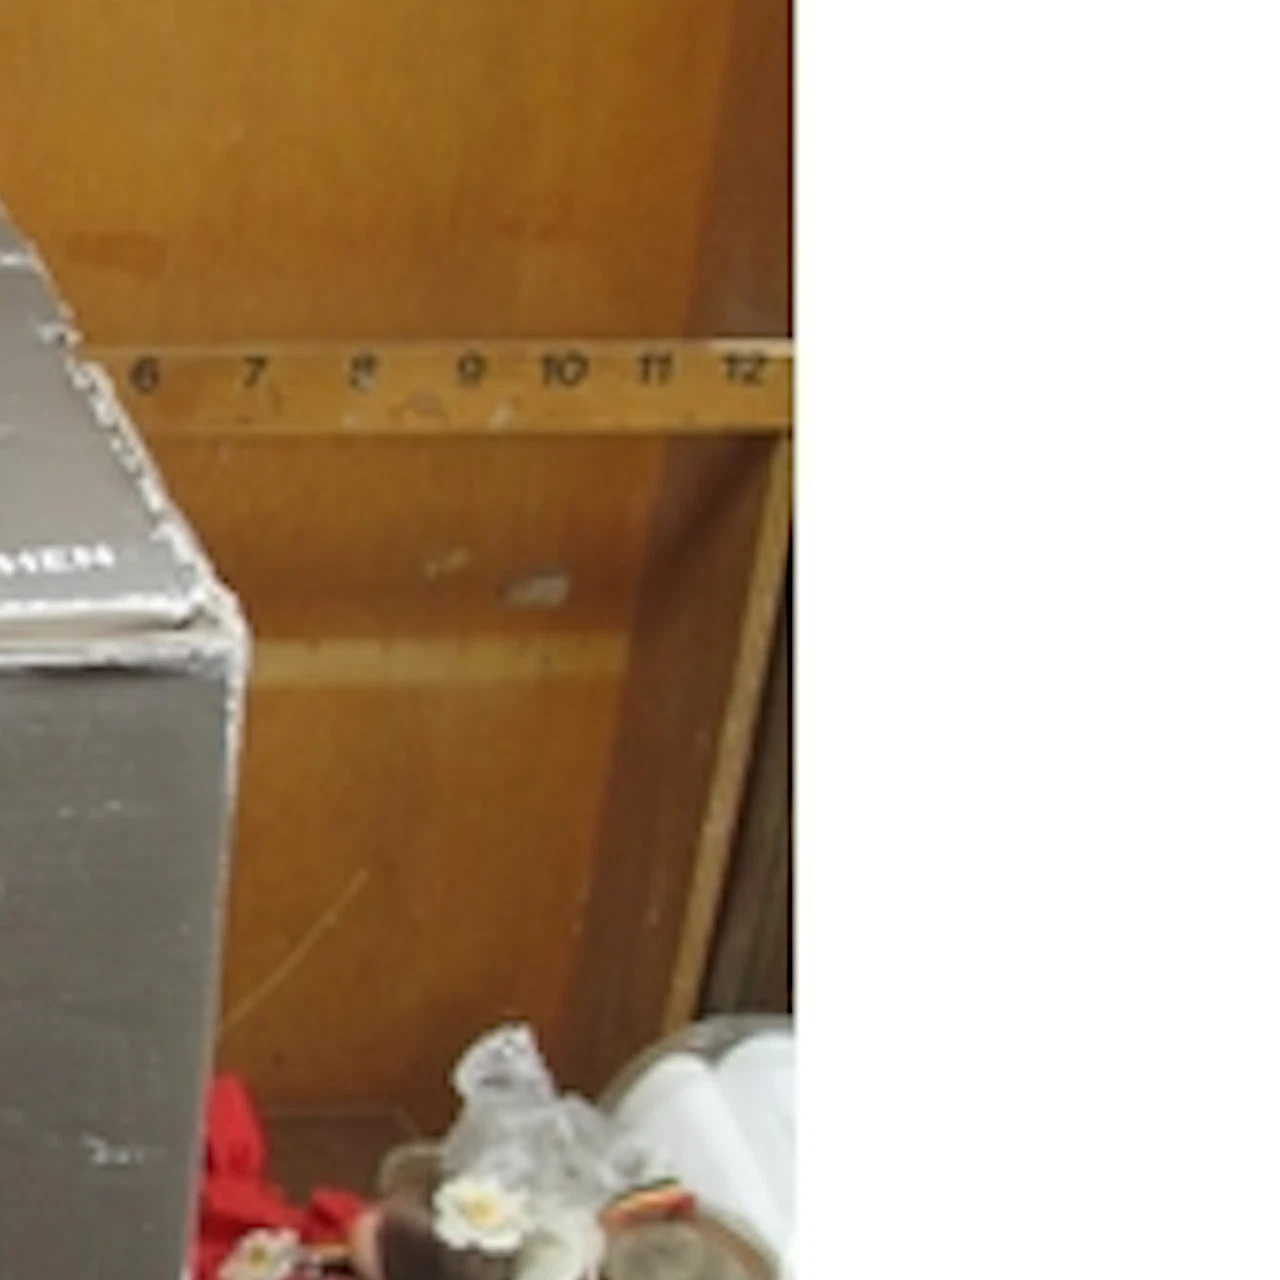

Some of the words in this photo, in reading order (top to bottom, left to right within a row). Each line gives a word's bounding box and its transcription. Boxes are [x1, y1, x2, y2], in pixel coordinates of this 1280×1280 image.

[129, 354, 161, 394] 6
[241, 355, 270, 389] 7
[456, 351, 489, 388] 9
[540, 351, 591, 389] 10
[636, 350, 674, 387] 11
[721, 350, 769, 387] 12
